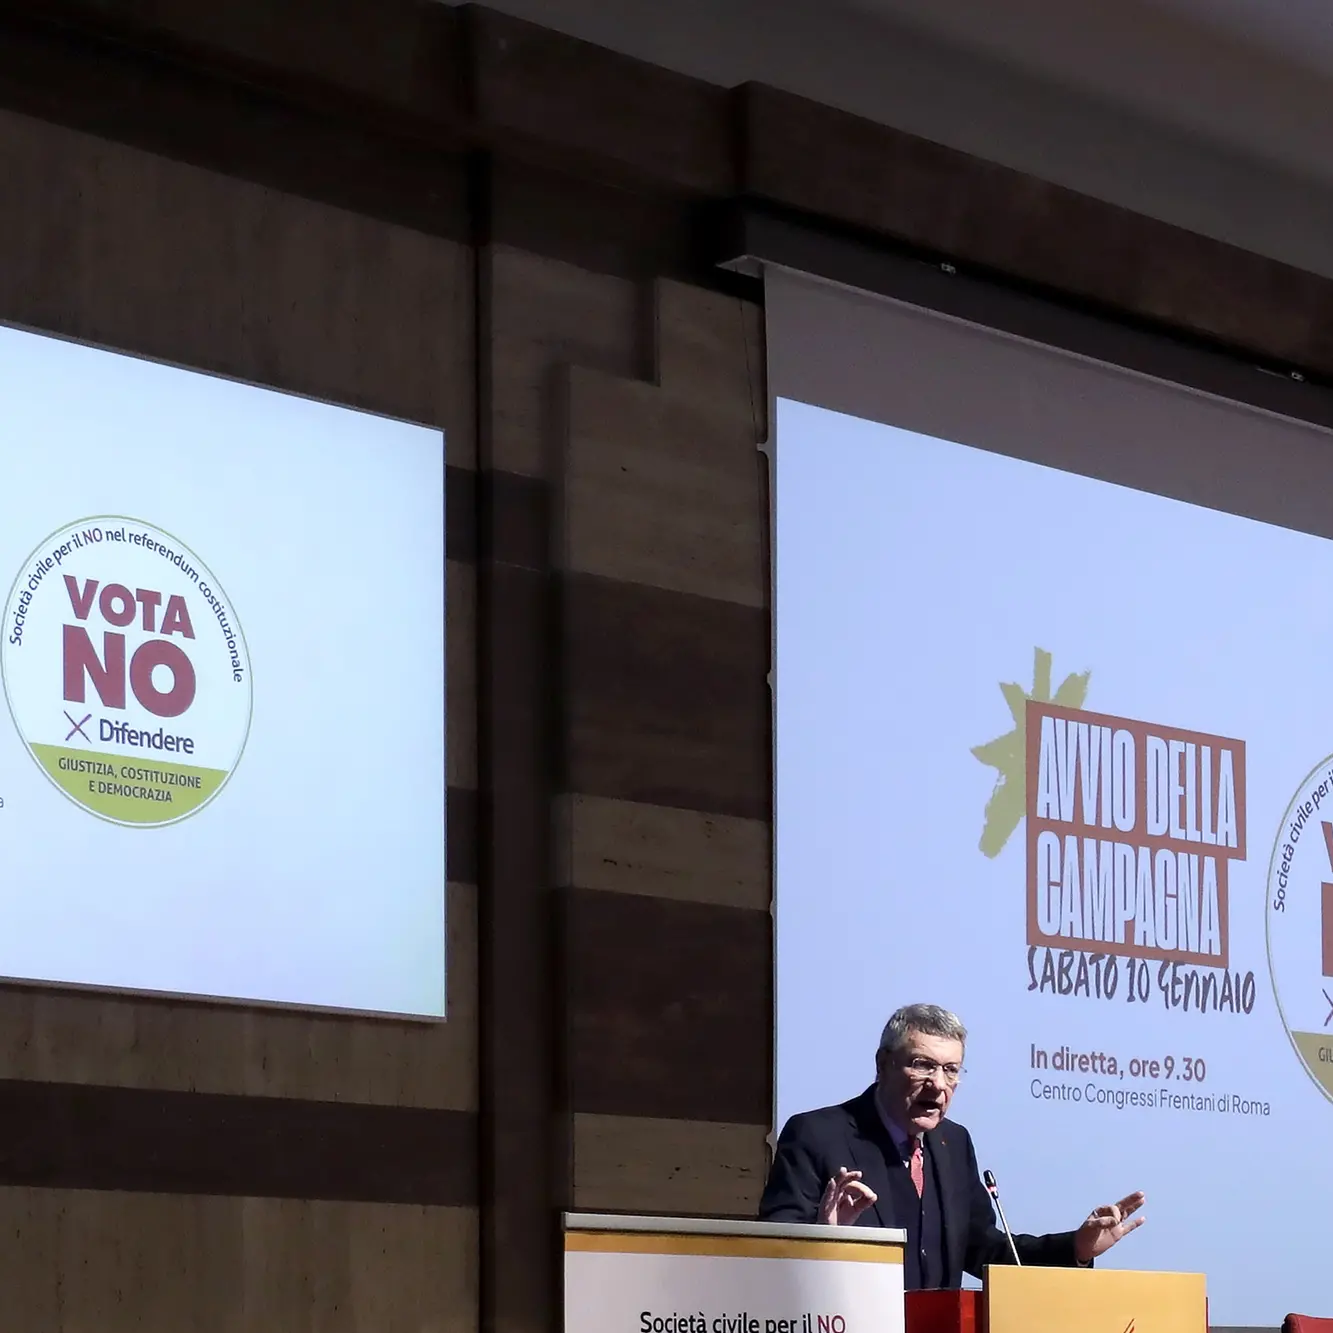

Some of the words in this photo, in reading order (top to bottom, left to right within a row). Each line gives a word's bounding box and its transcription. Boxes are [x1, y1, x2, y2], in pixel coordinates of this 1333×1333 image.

[9, 590, 33, 646] Società
[28, 557, 55, 591] civile
[53, 541, 72, 565] per
[71, 533, 84, 549] il
[82, 528, 103, 545] NO
[105, 527, 127, 542] nel
[128, 531, 200, 583] referendum
[198, 581, 245, 683] costituzionale
[62, 574, 196, 640] VOTA
[62, 623, 197, 718] NO
[99, 718, 195, 754] Difendere
[58, 757, 118, 779] GIUSTIZIA,
[121, 766, 201, 789] COSTITUZIONE
[88, 780, 95, 792] E
[98, 781, 173, 803] DEMOCRAZIA
[1036, 715, 1136, 832] AVVIO
[1146, 734, 1238, 848] DELLA
[1273, 843, 1295, 913] Società
[1289, 801, 1314, 844] civile
[1311, 780, 1330, 810] per
[1036, 830, 1222, 956] CAMPAGNA
[1027, 945, 1118, 1000] SABATO
[1126, 957, 1150, 1003] 10
[1031, 1043, 1047, 1069] In
[1052, 1046, 1124, 1080] diretta,
[1129, 1057, 1160, 1078] ore
[1164, 1056, 1205, 1082] 9.30
[1031, 1079, 1082, 1101] Centro
[1085, 1083, 1157, 1109] Congressi
[1160, 1089, 1215, 1112] Frentani
[1218, 1094, 1229, 1112] di
[1233, 1095, 1270, 1116] Roma
[640, 1311, 707, 1333] Società
